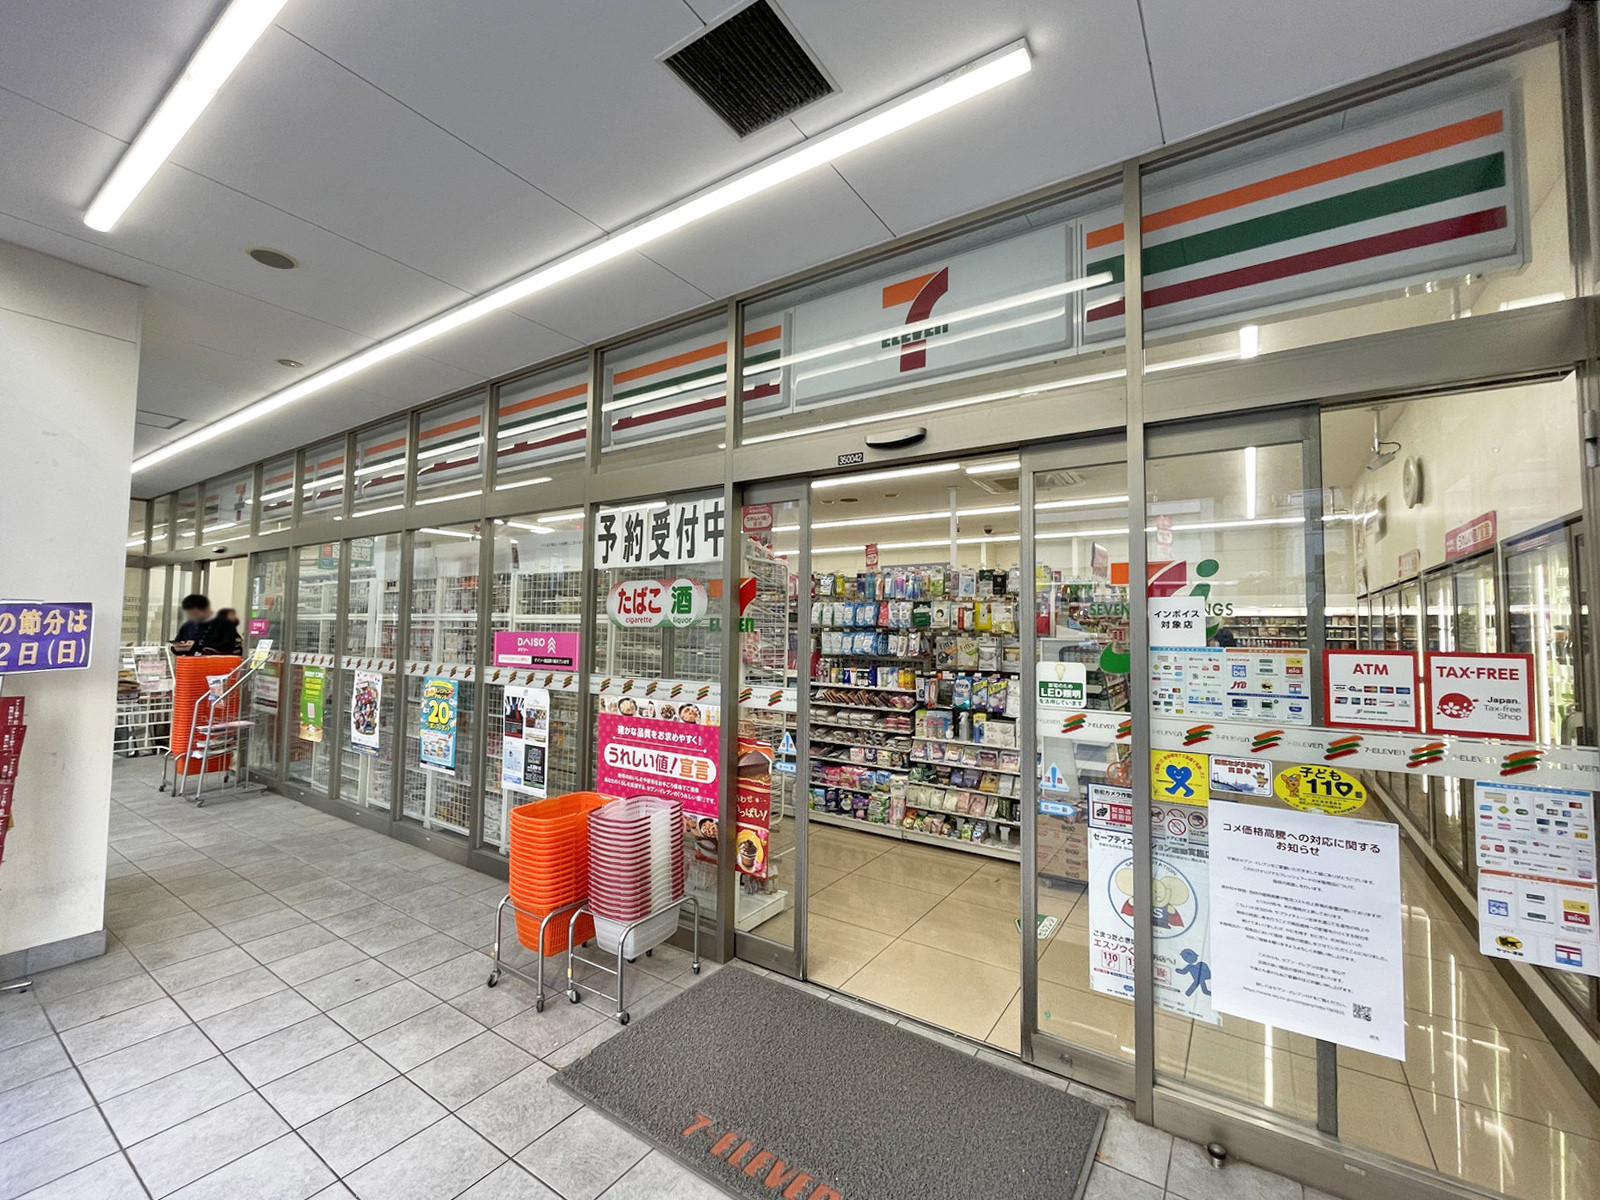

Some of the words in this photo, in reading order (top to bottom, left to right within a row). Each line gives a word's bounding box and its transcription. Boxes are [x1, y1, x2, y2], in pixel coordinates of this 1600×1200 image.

[838, 453, 863, 465] 350042
[598, 501, 724, 564] 予約受付中
[618, 586, 662, 615] たばこ
[670, 585, 693, 615] 酒
[1153, 609, 1201, 619] インボイス
[0, 609, 88, 636] の節分は
[625, 617, 653, 625] cigarette
[672, 616, 693, 624] liquor
[1161, 620, 1194, 630] 対象店
[517, 637, 546, 647] DAISO
[1352, 663, 1389, 675] ATM
[1436, 665, 1520, 681] TAX-FREE
[1230, 681, 1248, 690] JTB
[428, 699, 450, 724] 20
[1484, 704, 1522, 713] Tax-free
[1497, 713, 1522, 721] Shop
[1300, 766, 1342, 781] 子ども
[1222, 822, 1381, 855] コメ価格高騰への対応に関する
[1276, 841, 1320, 857] お知らせ
[1103, 951, 1118, 962] 110
